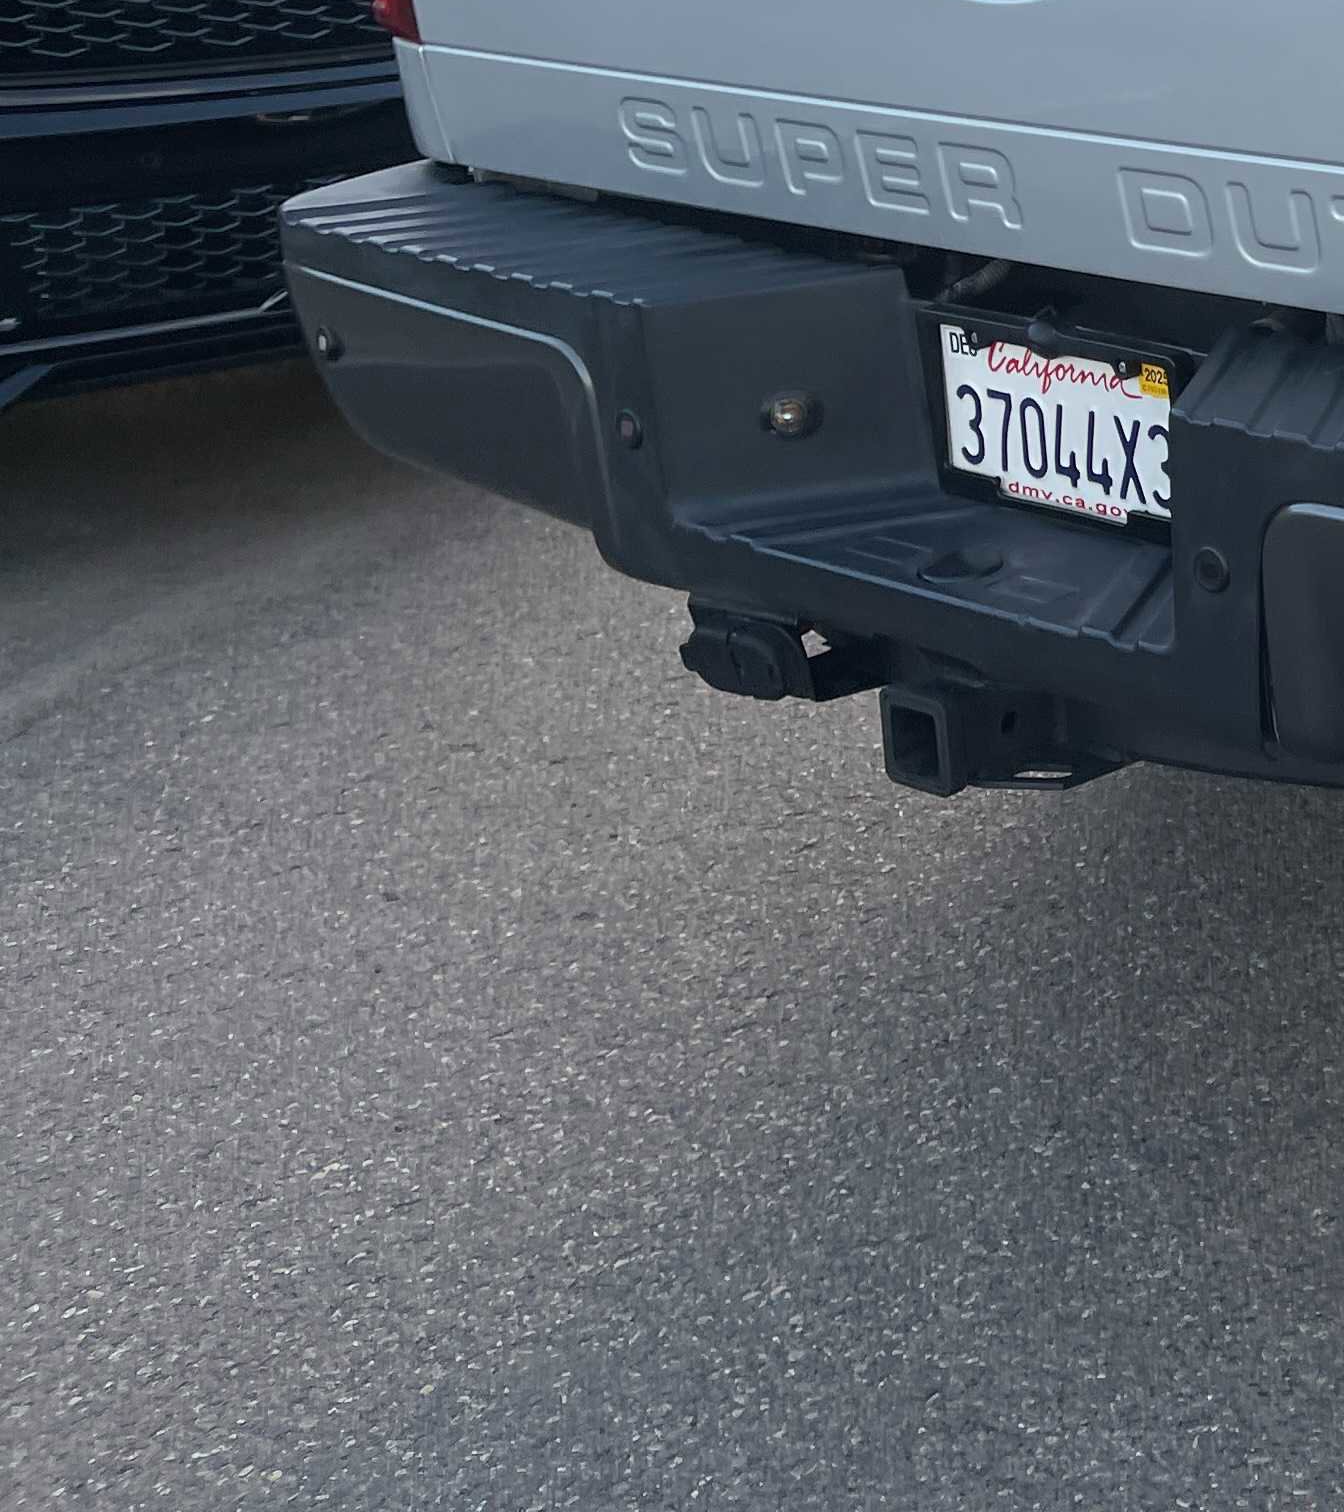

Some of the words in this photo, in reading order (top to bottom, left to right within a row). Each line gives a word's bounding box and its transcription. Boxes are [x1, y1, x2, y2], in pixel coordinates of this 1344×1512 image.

[617, 95, 1023, 230] SUPER
[987, 340, 1142, 399] California
[956, 384, 1171, 510] 37044X3
[1008, 481, 1128, 517] dmv.ca.go
